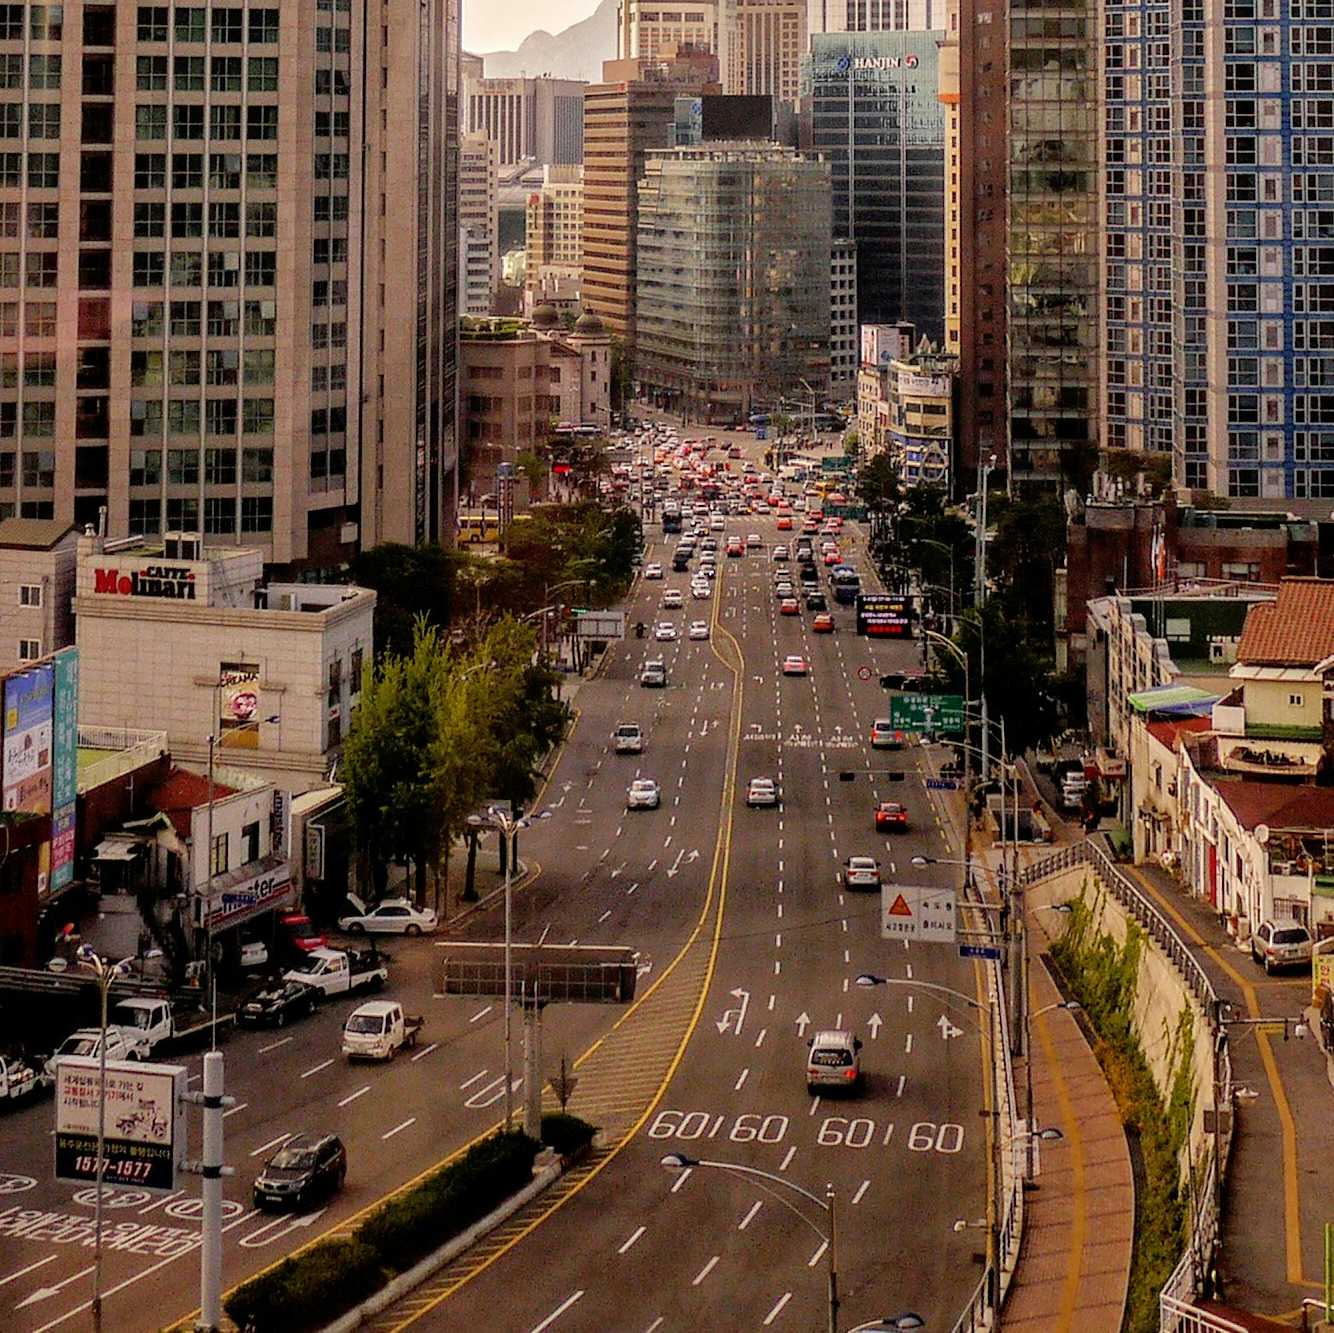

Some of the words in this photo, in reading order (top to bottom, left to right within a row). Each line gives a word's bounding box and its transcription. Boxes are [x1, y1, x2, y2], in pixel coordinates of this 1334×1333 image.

[854, 57, 900, 70] HANJIN
[95, 569, 195, 599] Molinari
[222, 878, 275, 914] mter
[648, 1110, 711, 1141] 60
[729, 1114, 789, 1144] 60
[817, 1118, 875, 1148] 60
[907, 1123, 965, 1154] 60
[75, 1156, 152, 1178] 1577-1577
